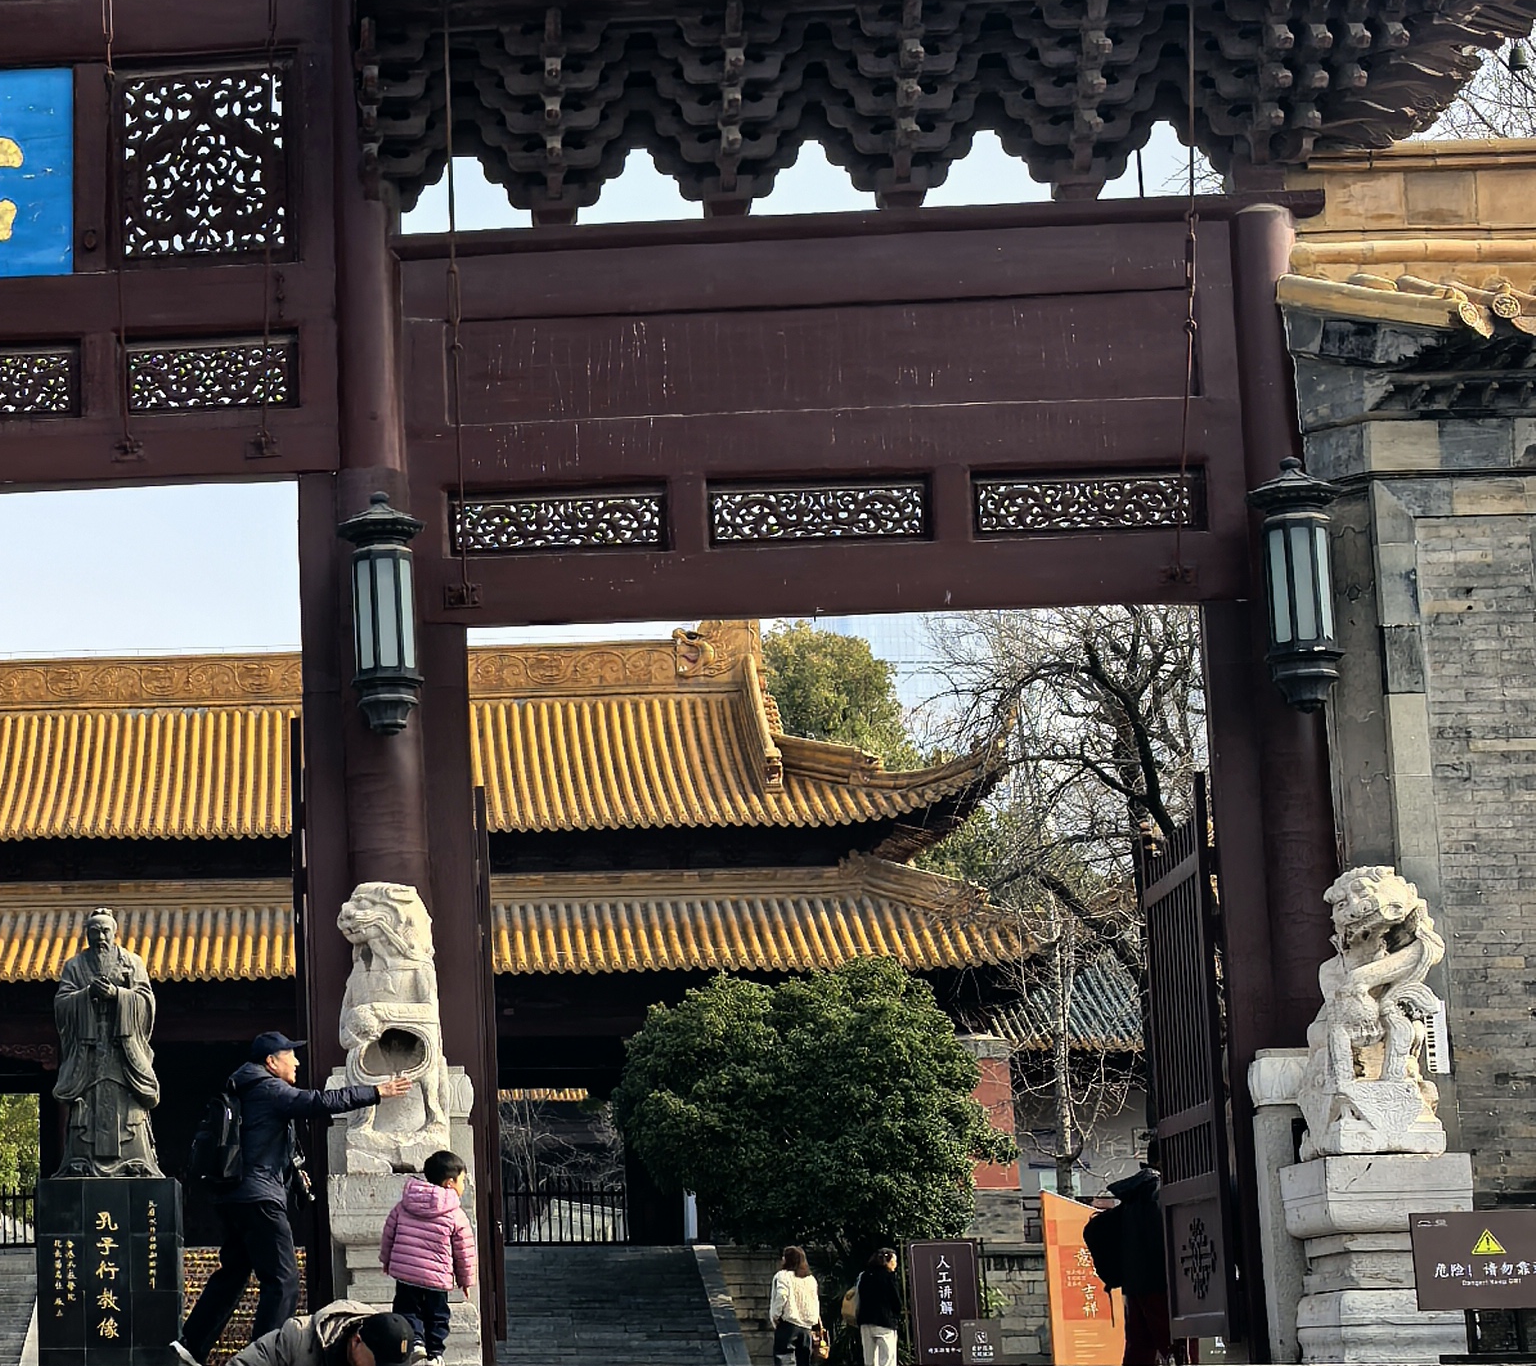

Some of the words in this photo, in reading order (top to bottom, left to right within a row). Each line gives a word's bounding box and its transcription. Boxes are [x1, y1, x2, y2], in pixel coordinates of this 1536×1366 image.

[96, 1211, 121, 1338] 孔子行教像
[936, 1255, 954, 1315] 人工讲解
